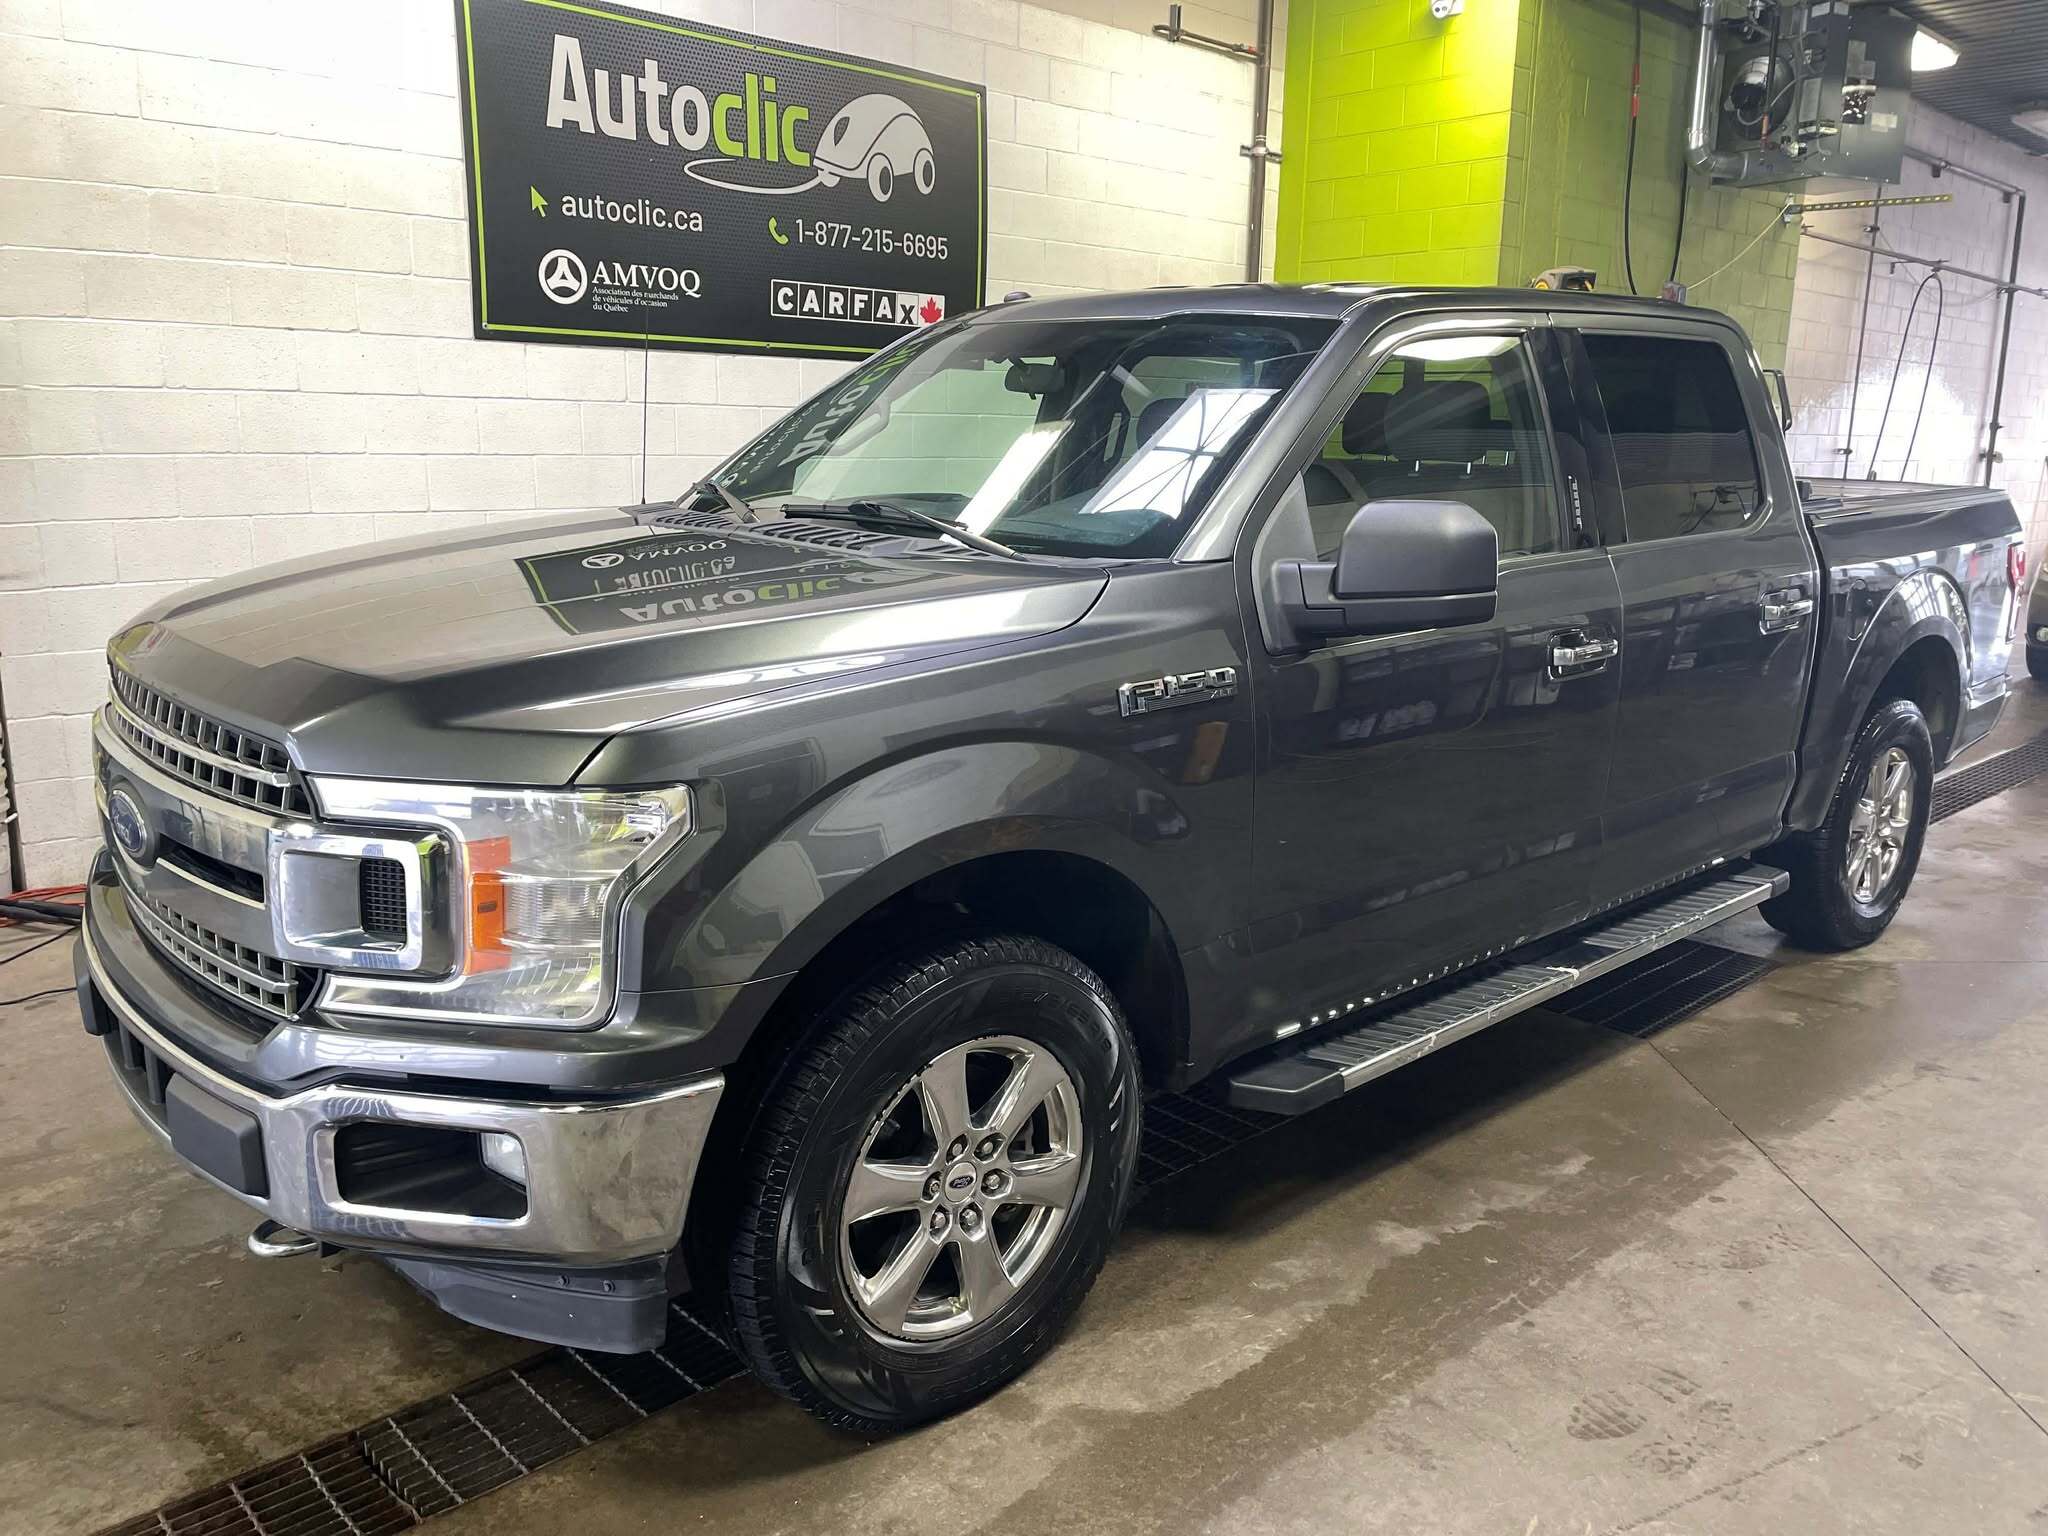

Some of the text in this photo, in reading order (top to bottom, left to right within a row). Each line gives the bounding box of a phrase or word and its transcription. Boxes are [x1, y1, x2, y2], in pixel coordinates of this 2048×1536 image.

[545, 33, 811, 167] Autoclic
[560, 194, 703, 232] autoclic.ca
[795, 218, 948, 260] 1-877-215-6695
[592, 260, 702, 298] AMVOQ
[592, 286, 679, 301] Association des marchands
[592, 294, 602, 303] de
[602, 295, 633, 306] véhicules
[592, 303, 629, 313] du Québec
[777, 286, 915, 325] CARFAX
